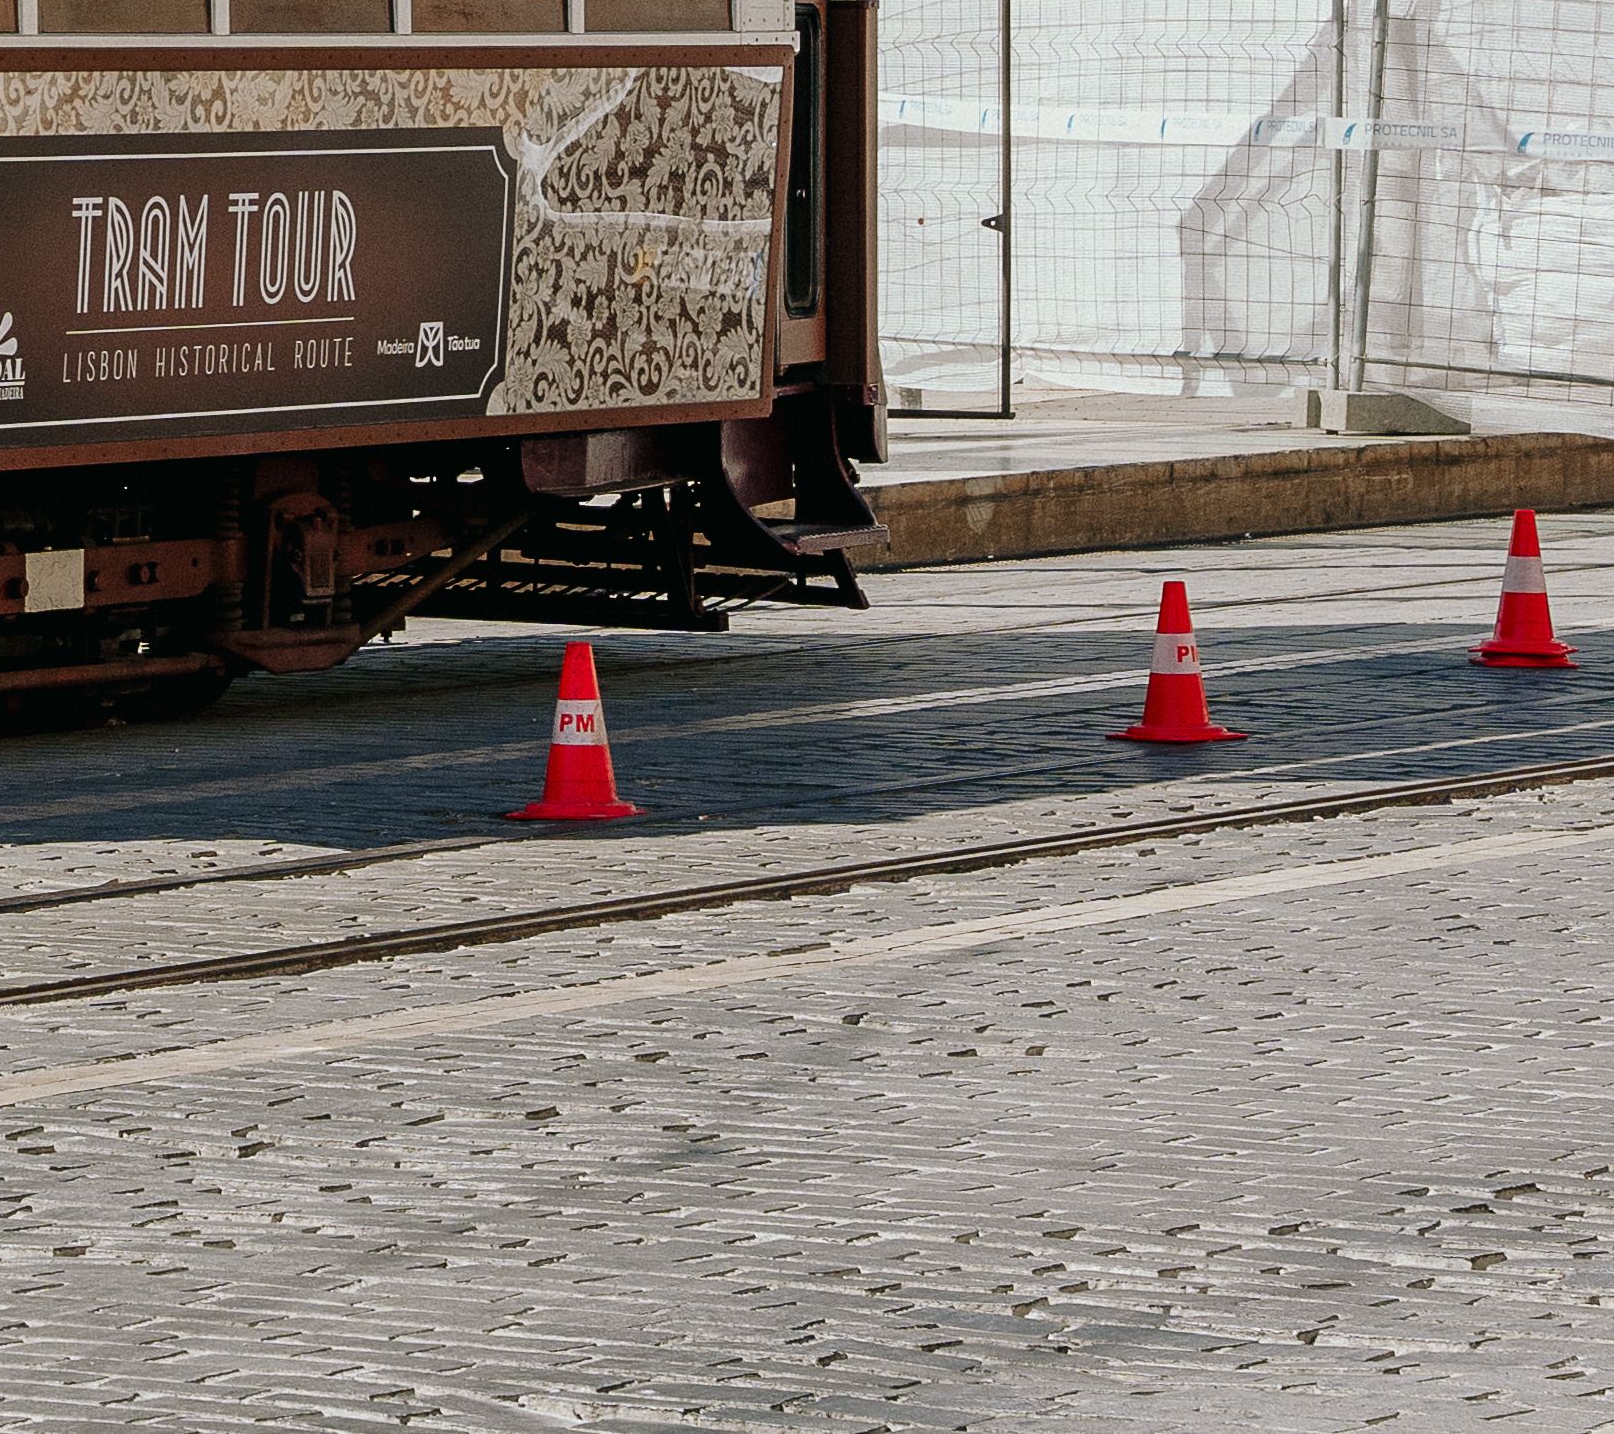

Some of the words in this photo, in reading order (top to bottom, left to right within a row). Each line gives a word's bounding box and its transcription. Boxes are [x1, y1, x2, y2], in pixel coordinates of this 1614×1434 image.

[1364, 123, 1437, 138] PROTECNIL
[1440, 126, 1458, 139] SA
[72, 194, 209, 314] TRAM
[228, 189, 357, 307] TOUR
[376, 338, 415, 355] Madeira
[464, 336, 481, 350] tua
[62, 348, 138, 383] LISBON
[155, 341, 276, 378] HISTORICAL
[294, 336, 354, 369] ROUTE
[559, 714, 595, 733] PM
